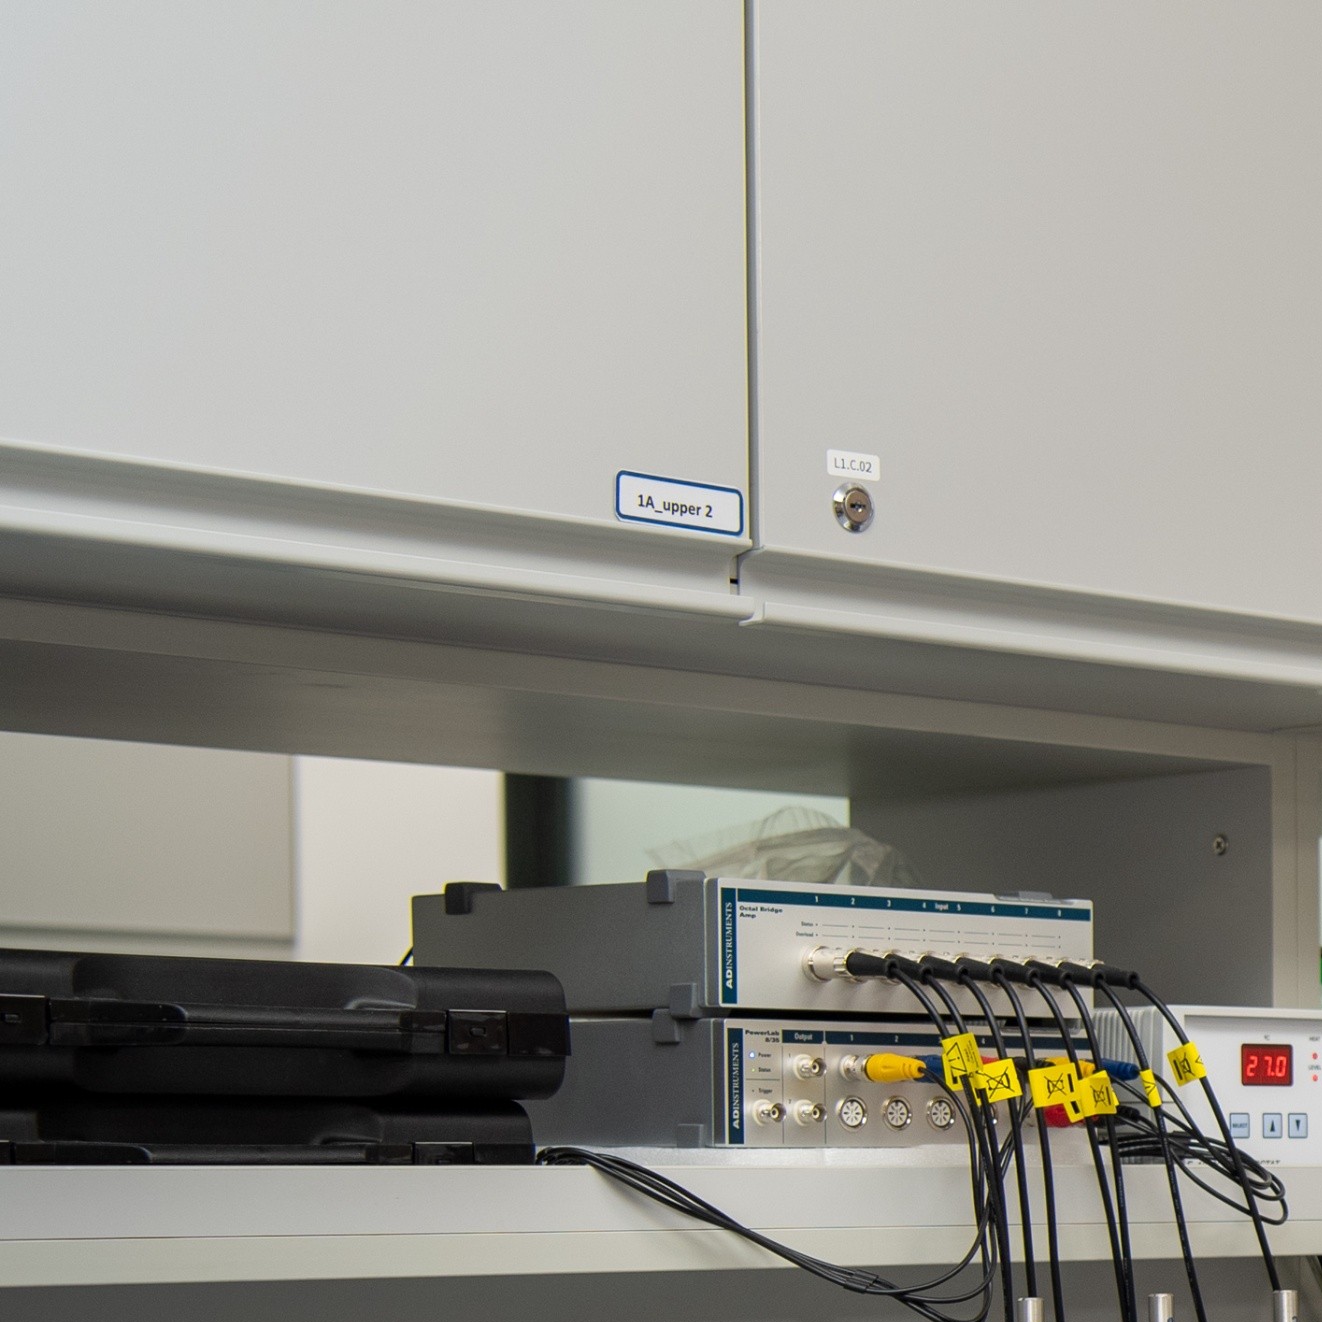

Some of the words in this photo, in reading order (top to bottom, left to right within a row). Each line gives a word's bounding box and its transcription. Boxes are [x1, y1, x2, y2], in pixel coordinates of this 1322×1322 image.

[834, 456, 872, 474] L1.C.02
[637, 493, 702, 518] 1A_upper
[705, 504, 714, 518] 2
[739, 905, 758, 913] Octal
[760, 906, 784, 914] Bridge
[850, 897, 856, 906] 2
[886, 899, 892, 908] 3
[956, 904, 962, 912] 5
[990, 905, 995, 914] 6
[725, 902, 734, 989] ADINSTRUMENTS
[794, 1032, 813, 1042] Output
[1246, 1056, 1287, 1077] 27.0
[732, 1042, 740, 1130] ADINSTRUMENTS
